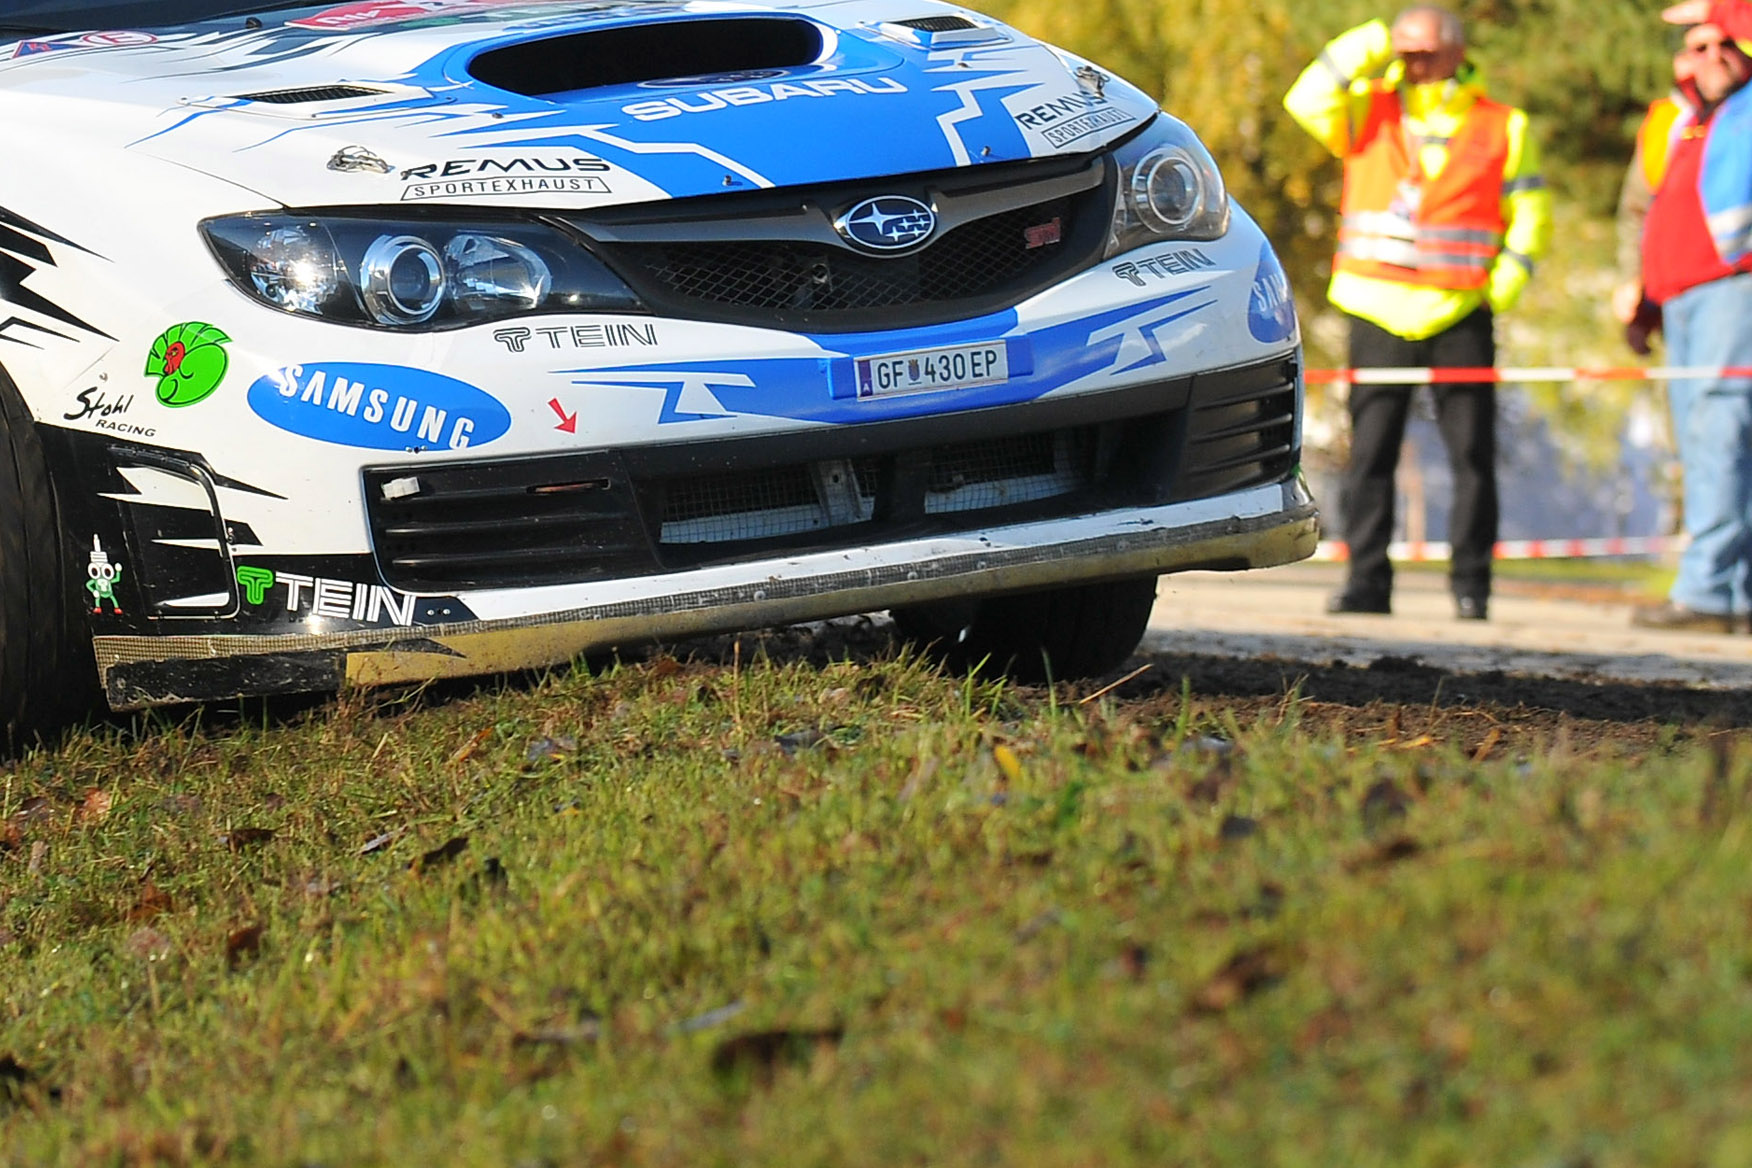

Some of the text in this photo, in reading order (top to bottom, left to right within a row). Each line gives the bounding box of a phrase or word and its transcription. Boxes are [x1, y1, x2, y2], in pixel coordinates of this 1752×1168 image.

[621, 77, 908, 121] SUBARU
[400, 158, 611, 181] REMUS
[414, 178, 594, 198] SPORTEXHAUST
[1136, 248, 1216, 280] TEIN
[535, 323, 658, 349] TEIN
[877, 360, 905, 389] GF
[63, 387, 134, 420] Stohl
[278, 364, 476, 450] SAMSUNG
[95, 419, 157, 437] RACING
[275, 571, 417, 626] TEIN
